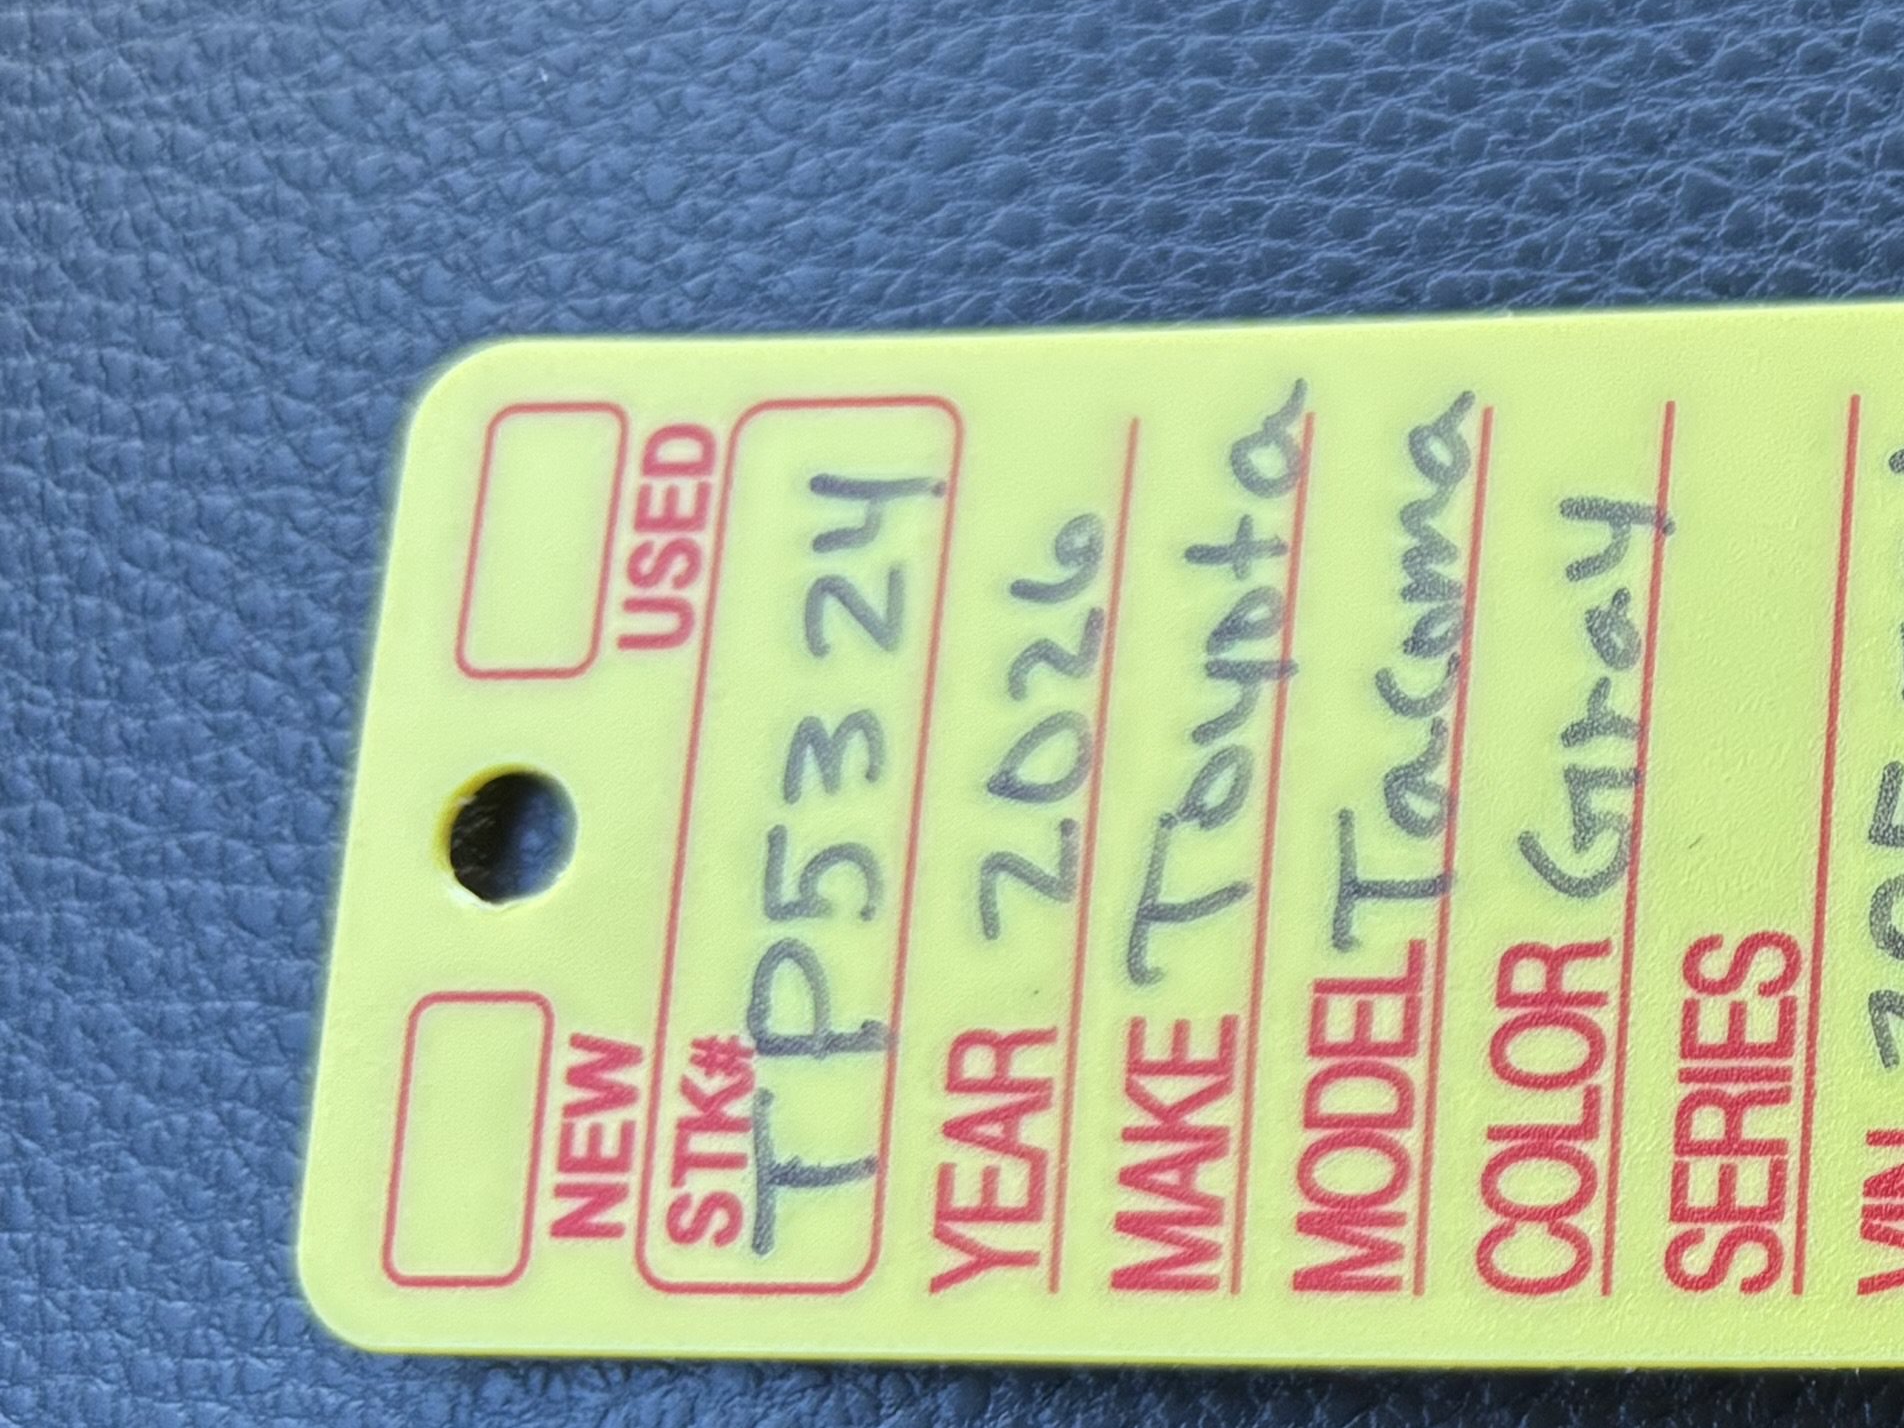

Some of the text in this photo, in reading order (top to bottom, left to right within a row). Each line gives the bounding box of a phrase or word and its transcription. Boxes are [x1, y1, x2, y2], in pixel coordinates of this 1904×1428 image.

[618, 424, 717, 651] USED
[929, 514, 1105, 1295] YEAR 2026
[1110, 379, 1307, 1292] MAKE Toyota
[1293, 392, 1475, 1294] MODEL Tacoma
[1476, 497, 1673, 1295] COLOR Gray
[1665, 931, 1801, 1295] SERIES
[551, 1032, 644, 1241] NEW
[666, 1034, 755, 1248] STK#
